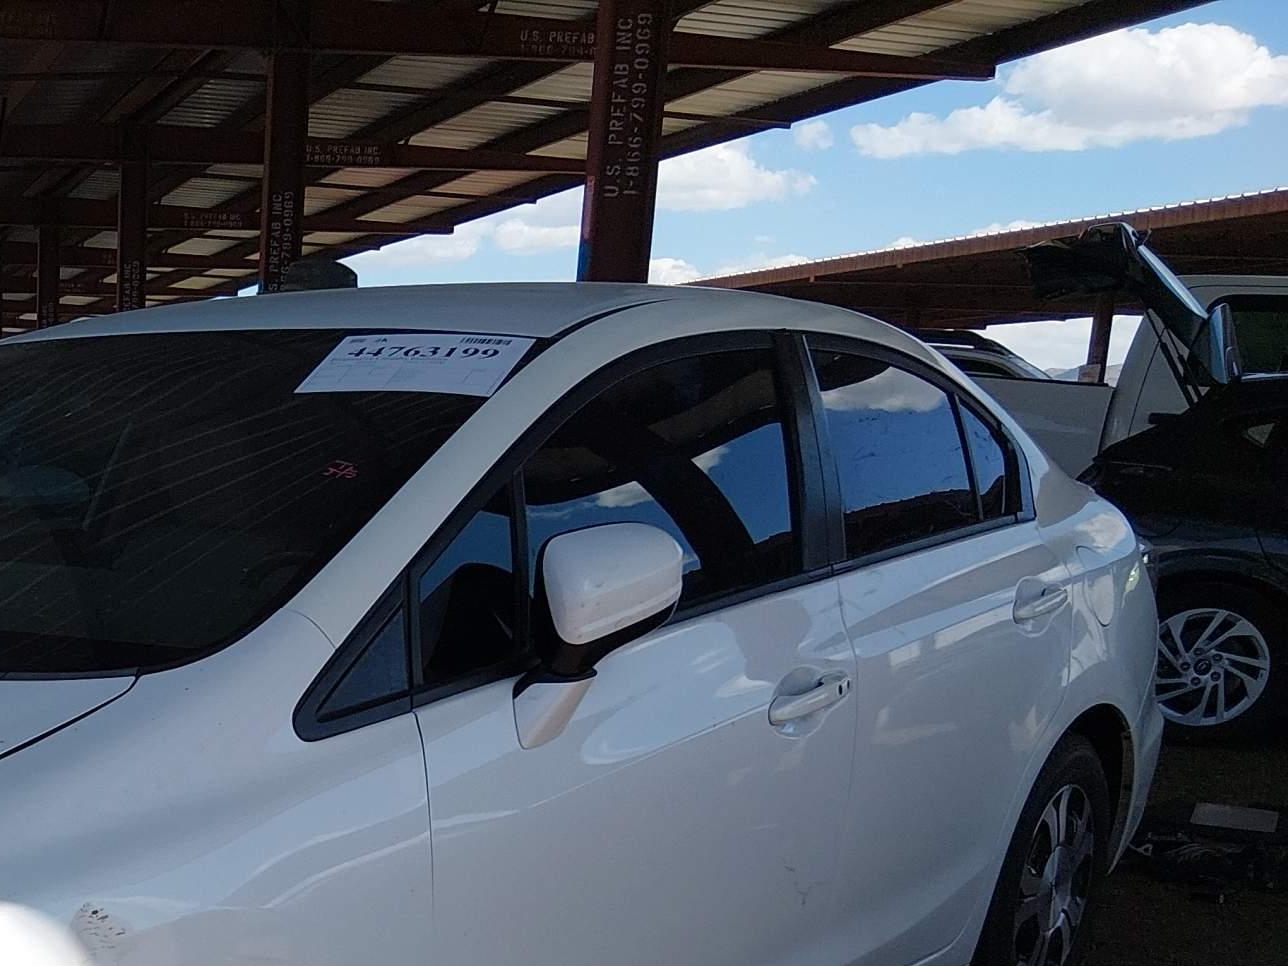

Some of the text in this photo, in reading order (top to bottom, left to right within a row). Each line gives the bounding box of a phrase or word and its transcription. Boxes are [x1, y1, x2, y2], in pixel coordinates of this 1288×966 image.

[549, 31, 595, 45] PREFAB
[607, 63, 630, 145] PREFAB
[623, 13, 653, 196] 1-866-799-0969
[603, 157, 622, 198] U.S.
[268, 221, 282, 273] PREFAB
[347, 345, 500, 360] 44763199
